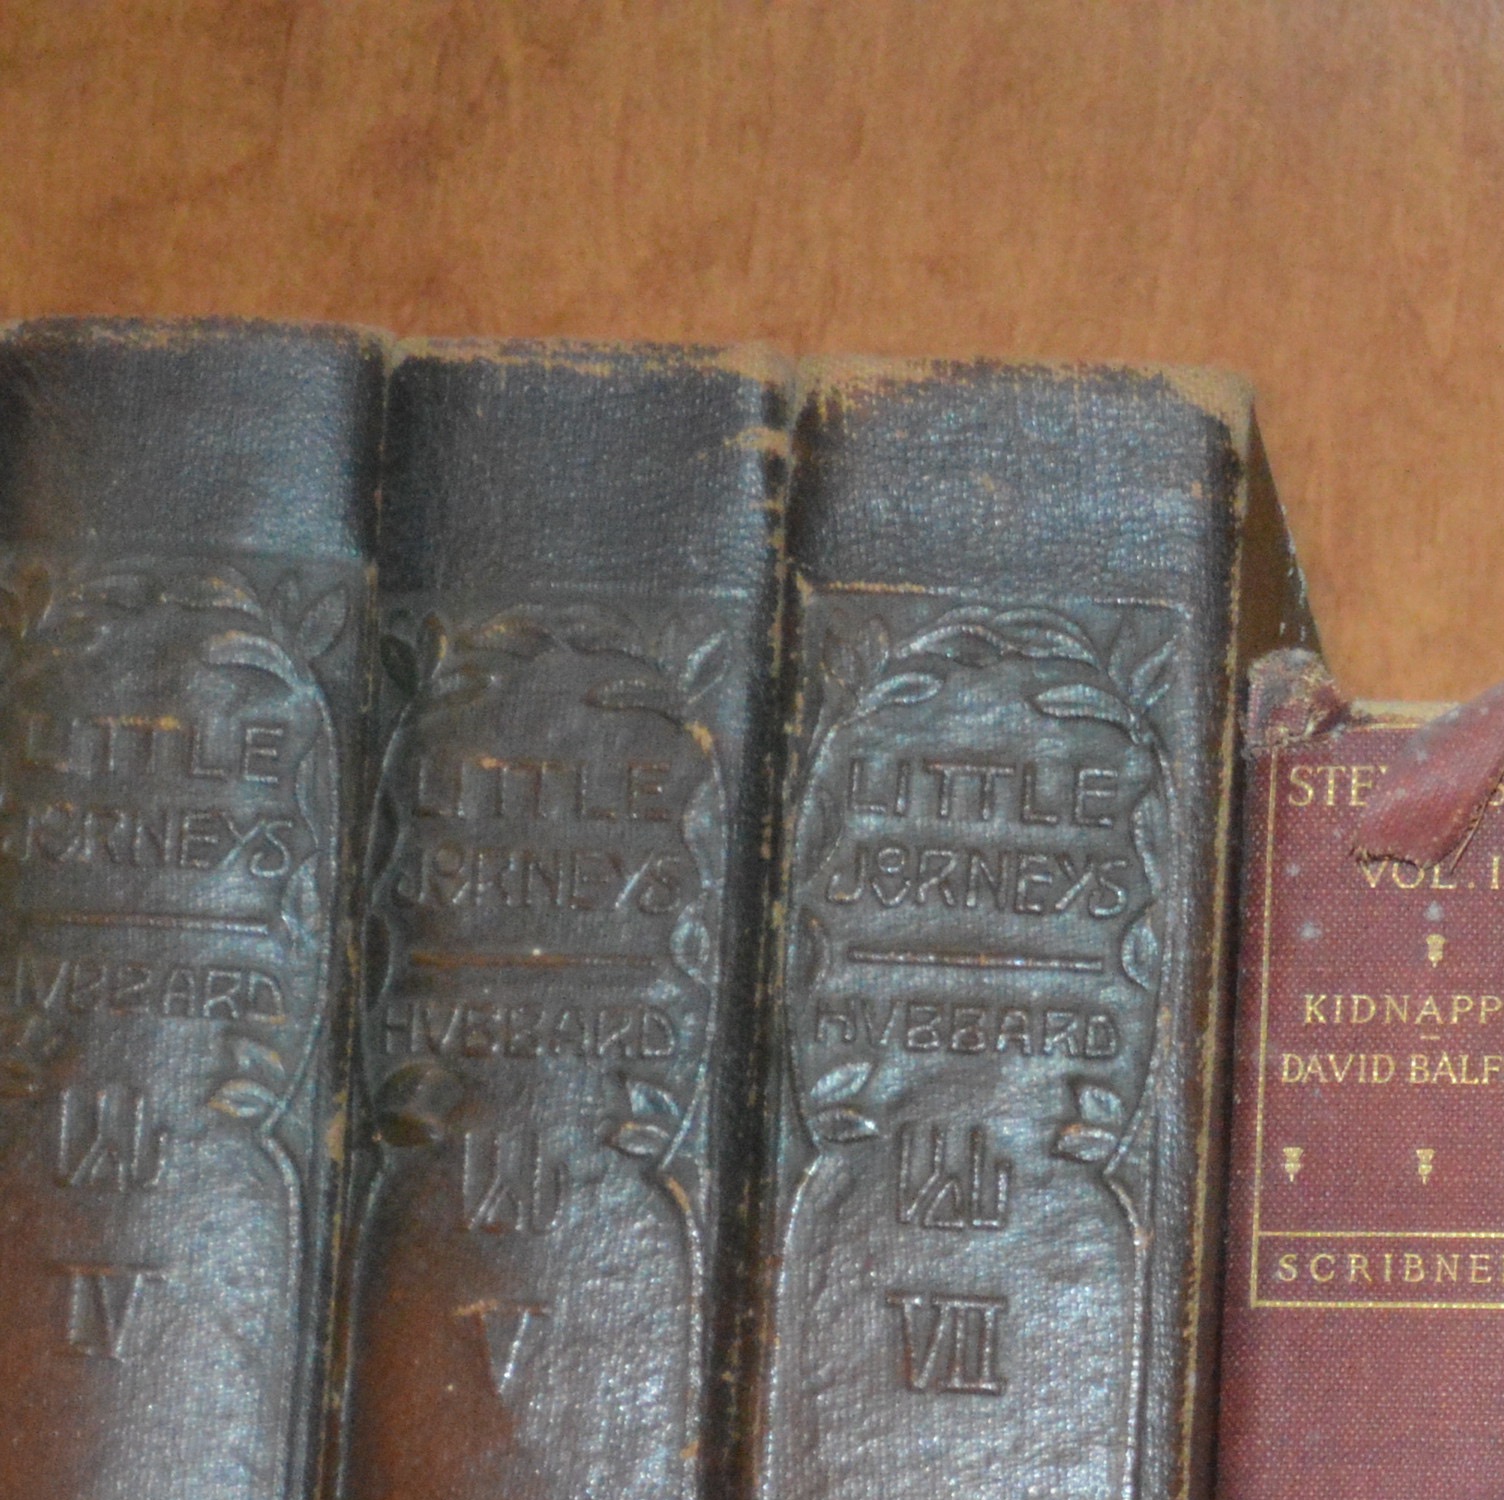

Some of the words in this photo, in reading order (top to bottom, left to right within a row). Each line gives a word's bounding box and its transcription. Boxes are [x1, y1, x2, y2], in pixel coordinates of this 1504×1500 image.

[412, 756, 674, 820] LITTLE
[850, 756, 1120, 828] LITTLE
[1361, 855, 1474, 891] VOL.
[1281, 1052, 1395, 1085] DAVID
[884, 1290, 1008, 1396] VII
